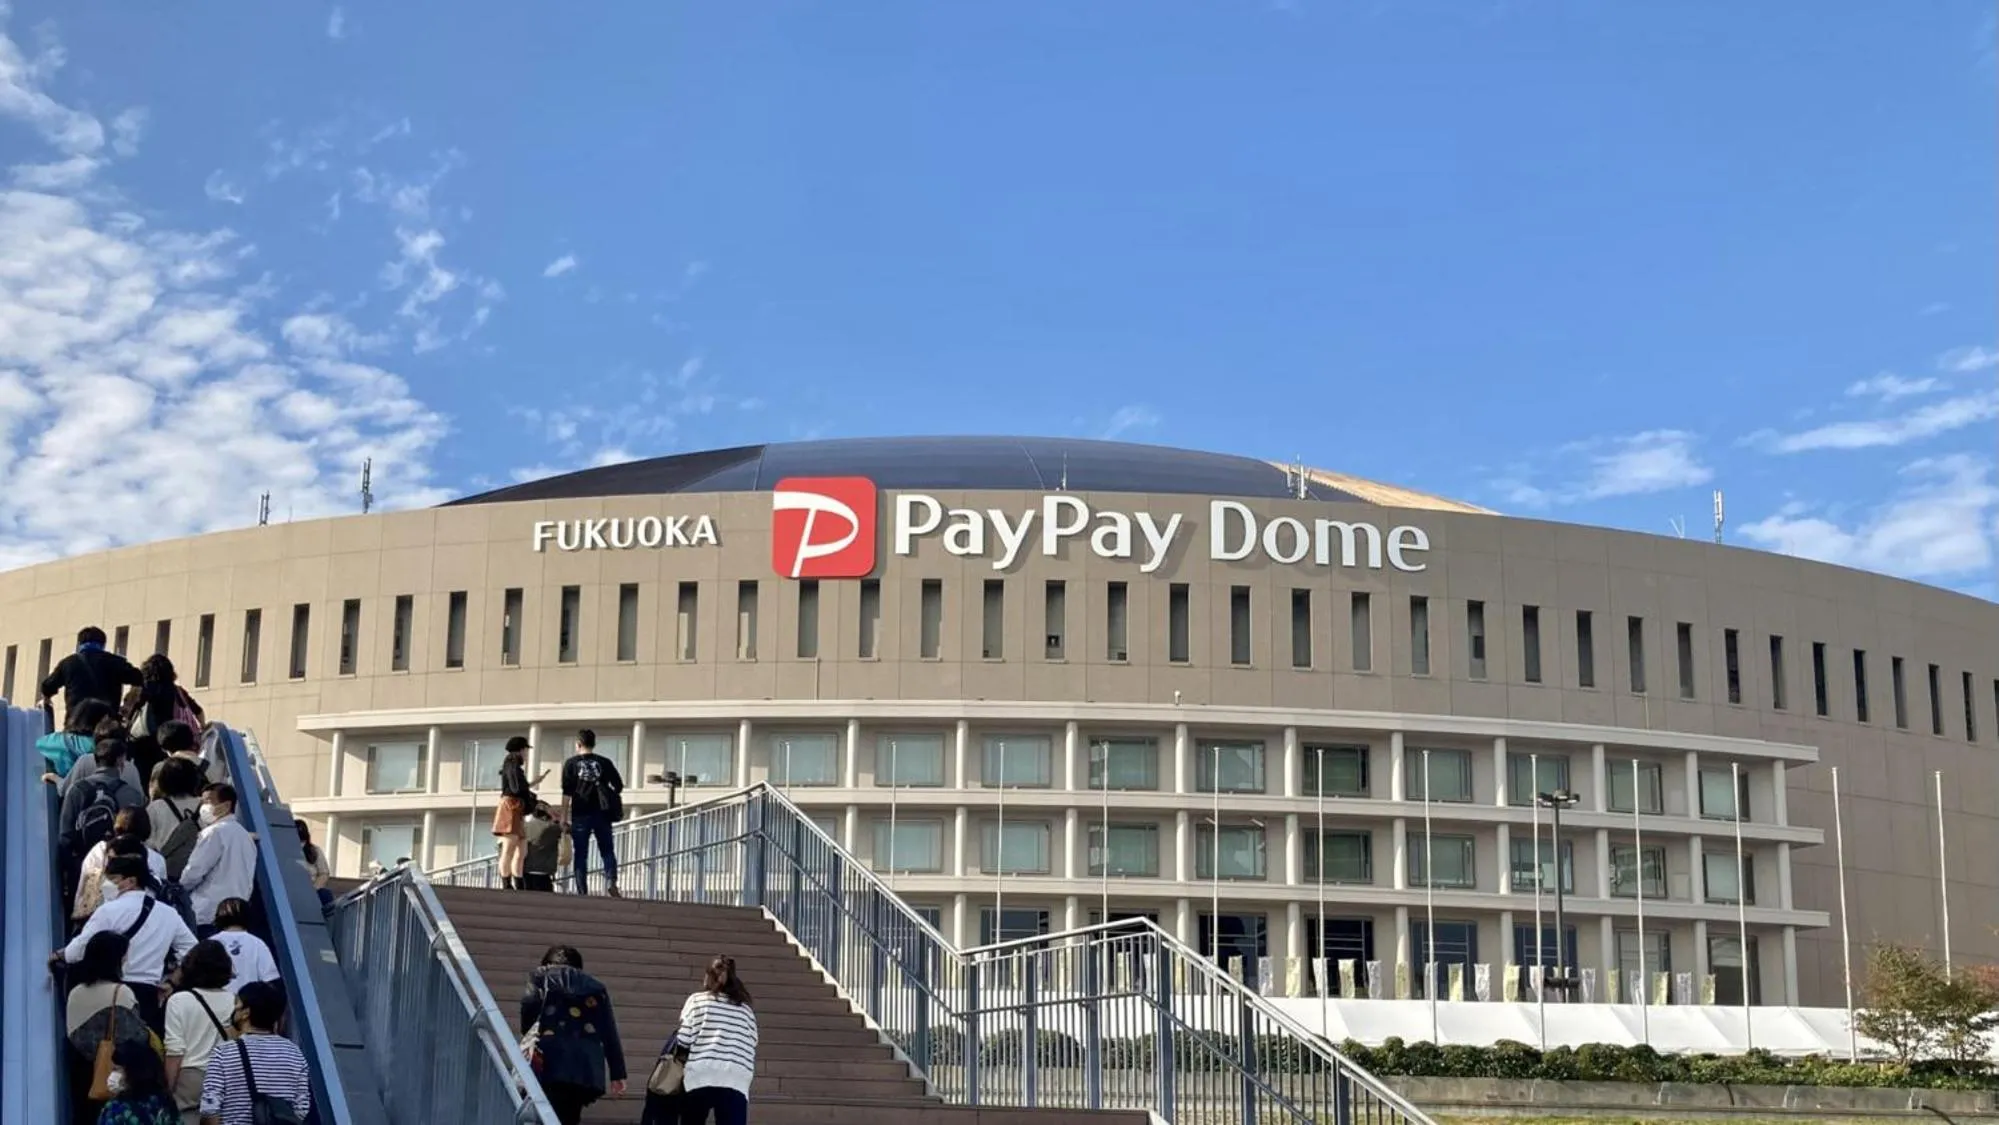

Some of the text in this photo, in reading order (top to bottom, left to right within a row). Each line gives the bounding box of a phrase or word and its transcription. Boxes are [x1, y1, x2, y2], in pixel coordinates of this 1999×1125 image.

[533, 514, 717, 551] FUKUOKA
[895, 494, 1182, 573] PayPay
[1210, 500, 1429, 571] Dome
